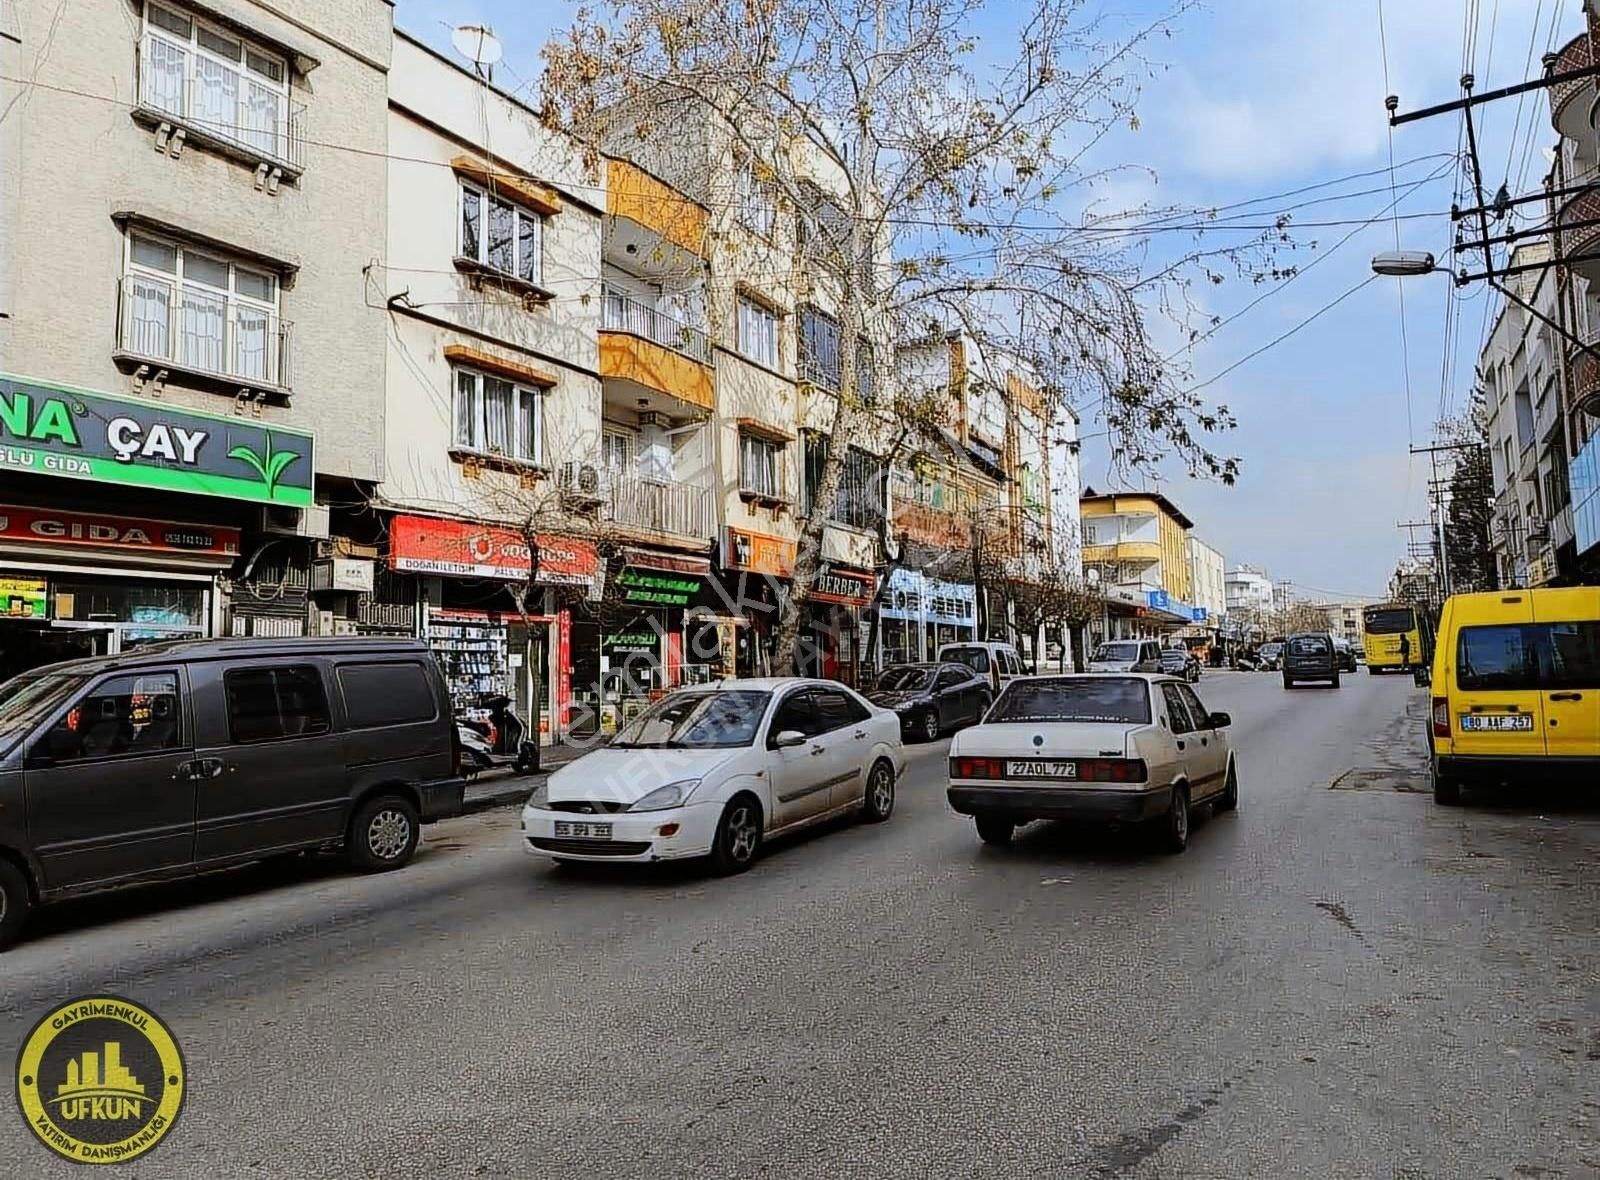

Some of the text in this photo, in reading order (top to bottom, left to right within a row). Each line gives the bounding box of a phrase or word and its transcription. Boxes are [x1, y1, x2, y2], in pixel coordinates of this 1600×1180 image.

[107, 417, 207, 464] ÇAY
[44, 456, 92, 474] GIDA
[30, 520, 152, 544] GIDA
[818, 575, 861, 597] BERBER
